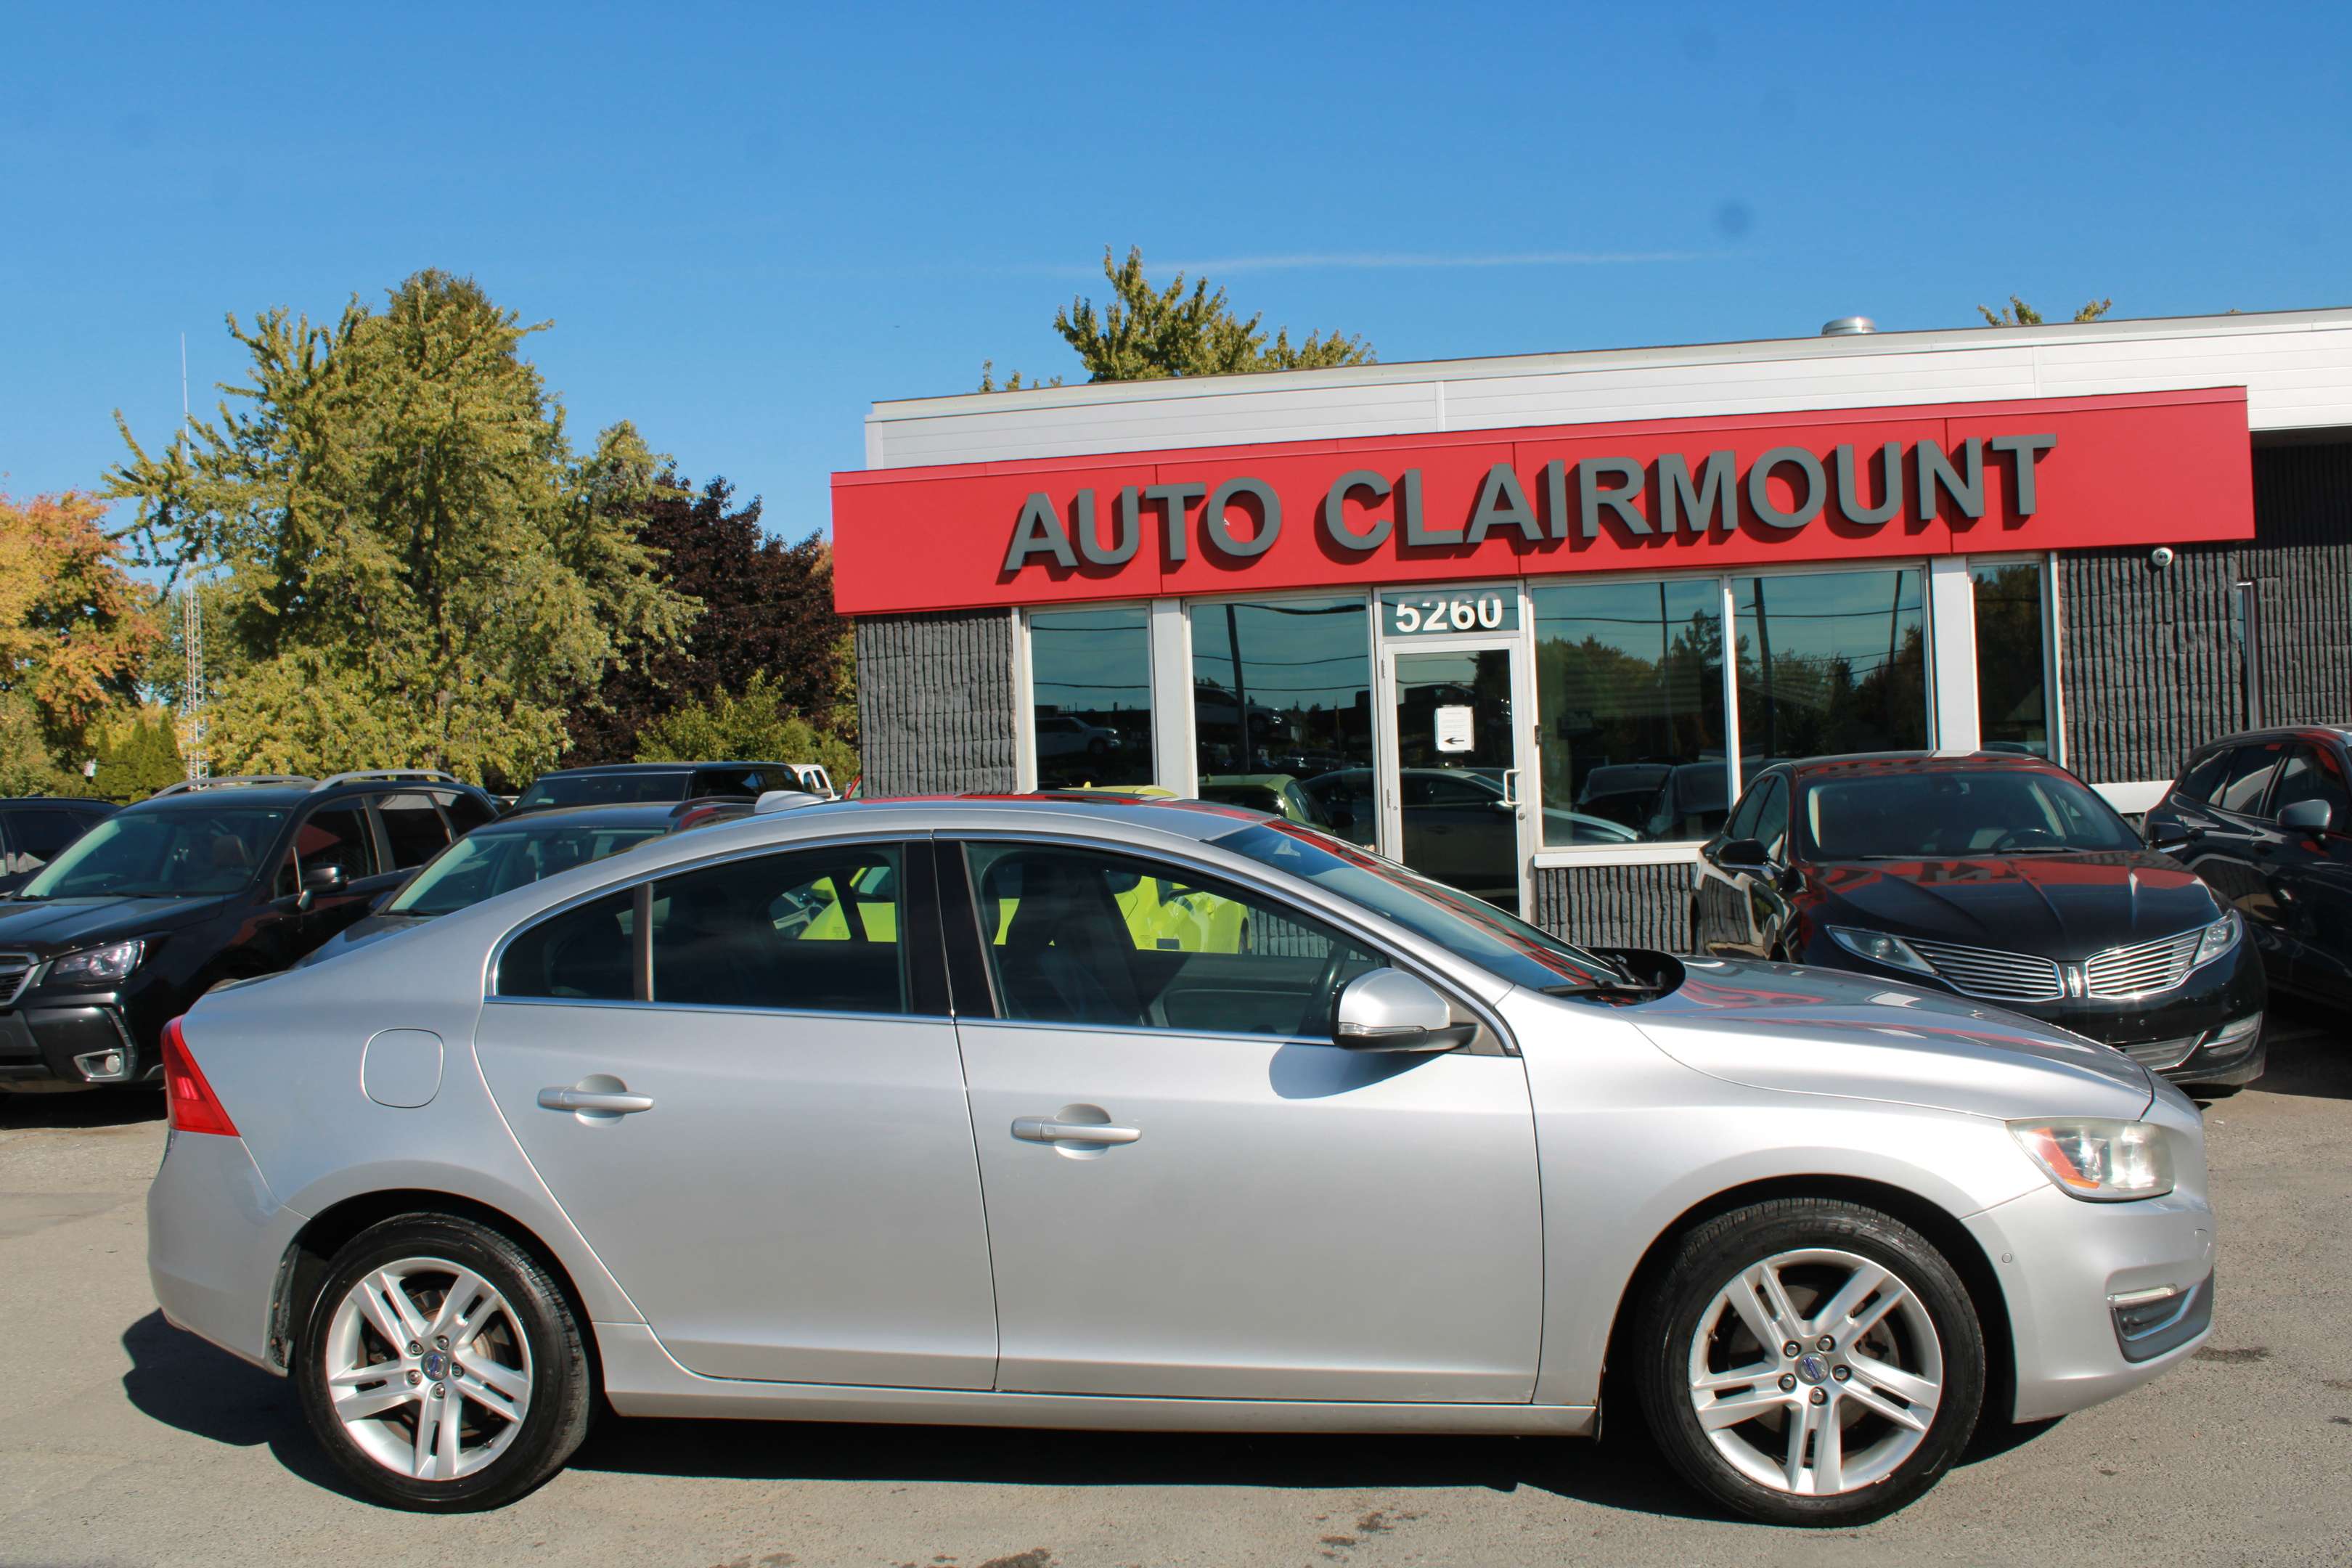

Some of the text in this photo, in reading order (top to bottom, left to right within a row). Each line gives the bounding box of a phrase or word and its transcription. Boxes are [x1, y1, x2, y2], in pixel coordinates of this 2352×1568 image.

[1005, 433, 2057, 571] AUTO CLAIRMOUNT
[1395, 592, 1503, 633] 5260
